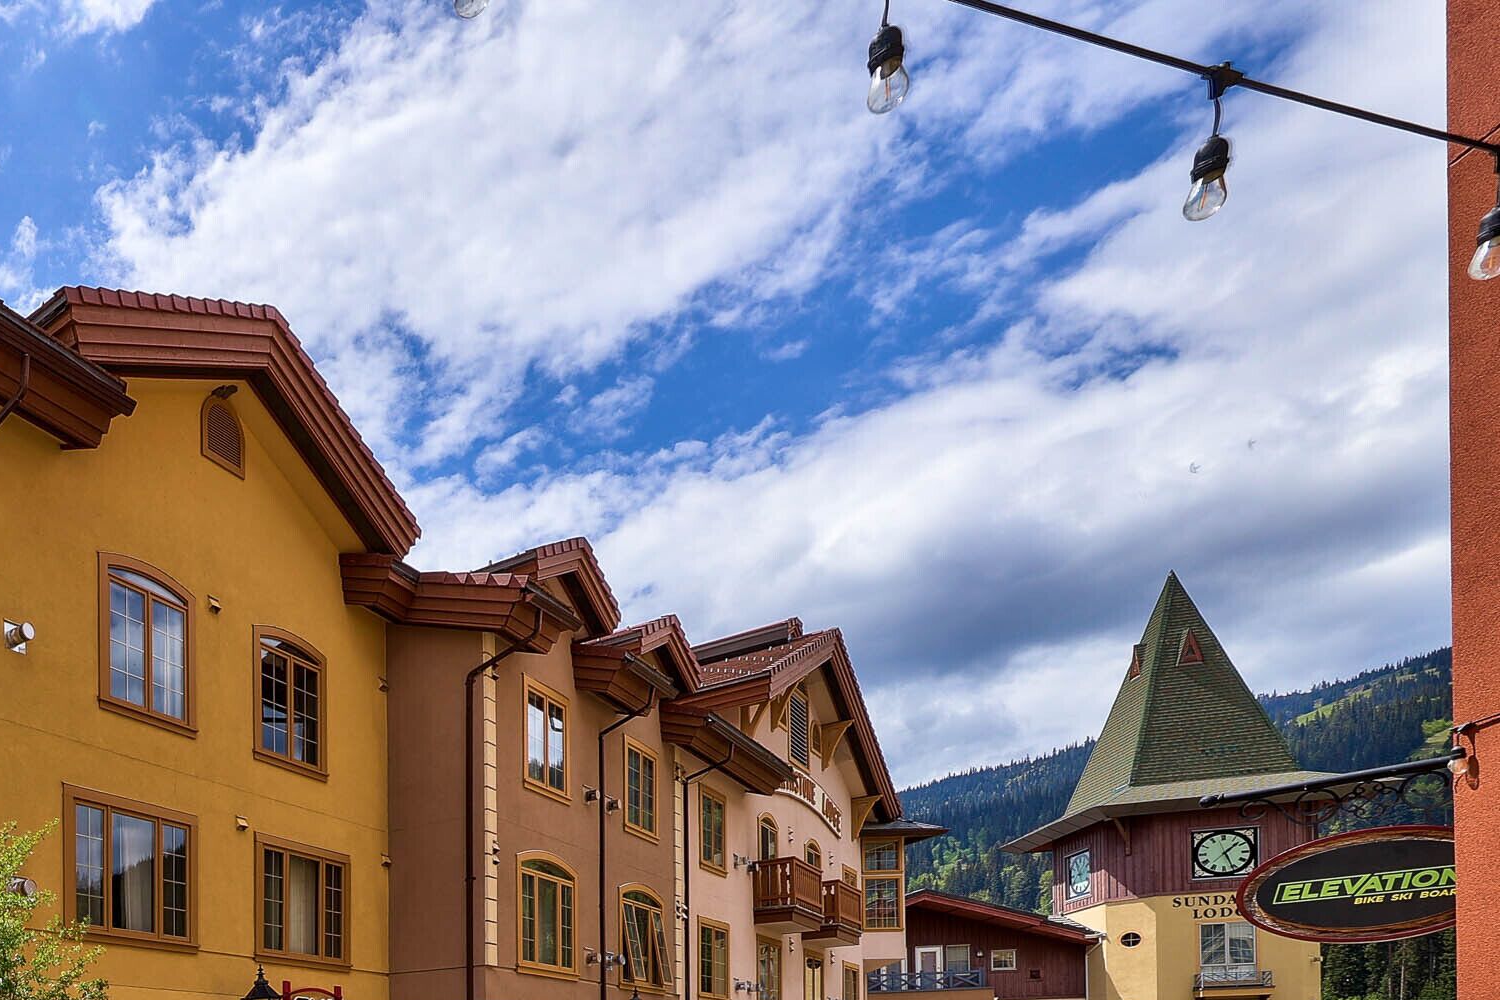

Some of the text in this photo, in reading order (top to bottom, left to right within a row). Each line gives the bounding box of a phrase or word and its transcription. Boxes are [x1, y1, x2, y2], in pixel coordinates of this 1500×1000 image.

[1281, 868, 1456, 902] ELEVATION
[1354, 895, 1385, 905] BIKE
[1390, 893, 1412, 901] SKI
